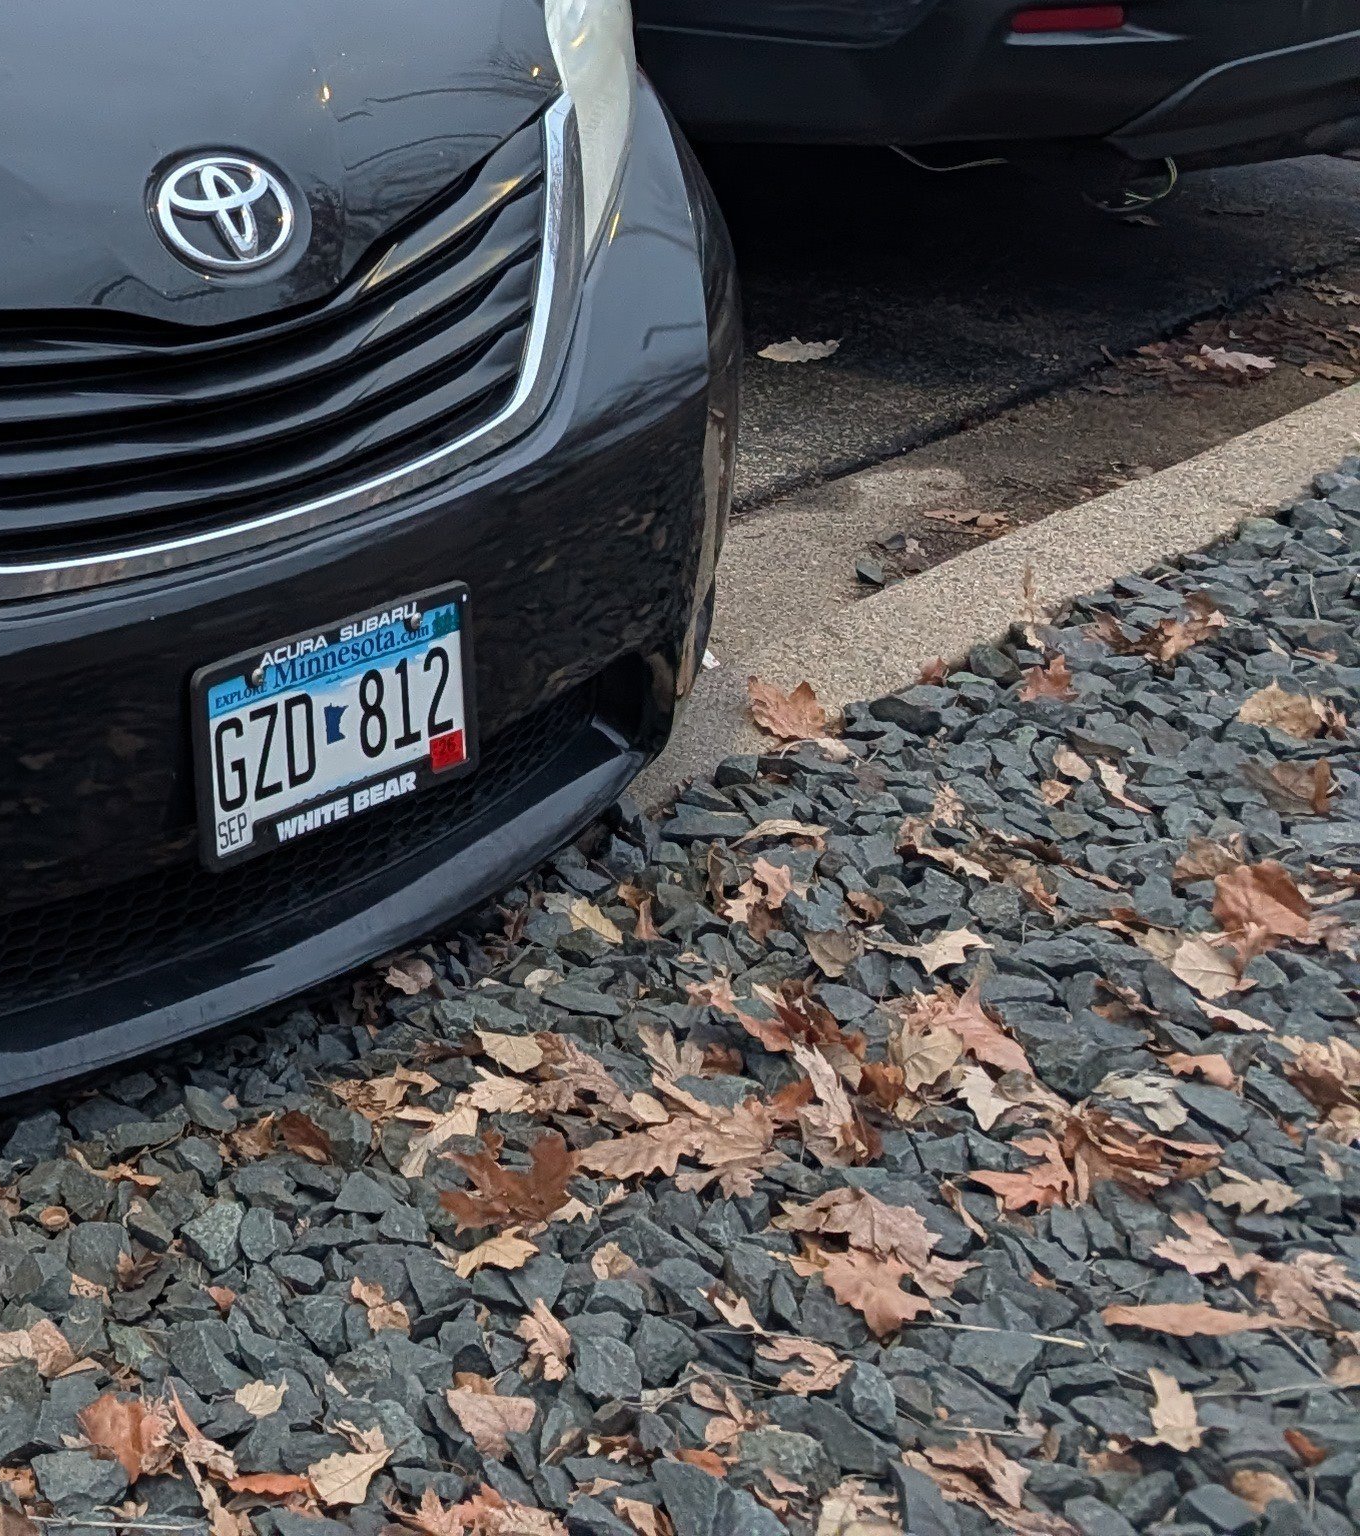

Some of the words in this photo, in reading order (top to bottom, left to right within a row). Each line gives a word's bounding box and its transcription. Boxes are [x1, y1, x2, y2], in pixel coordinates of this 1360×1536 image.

[259, 635, 328, 670] ACURA
[339, 602, 417, 640] SUBARU
[214, 692, 317, 812] GZD
[359, 647, 453, 759] 812
[217, 812, 247, 850] SEP
[276, 797, 350, 843] WHITE
[353, 771, 417, 813] BEAR
